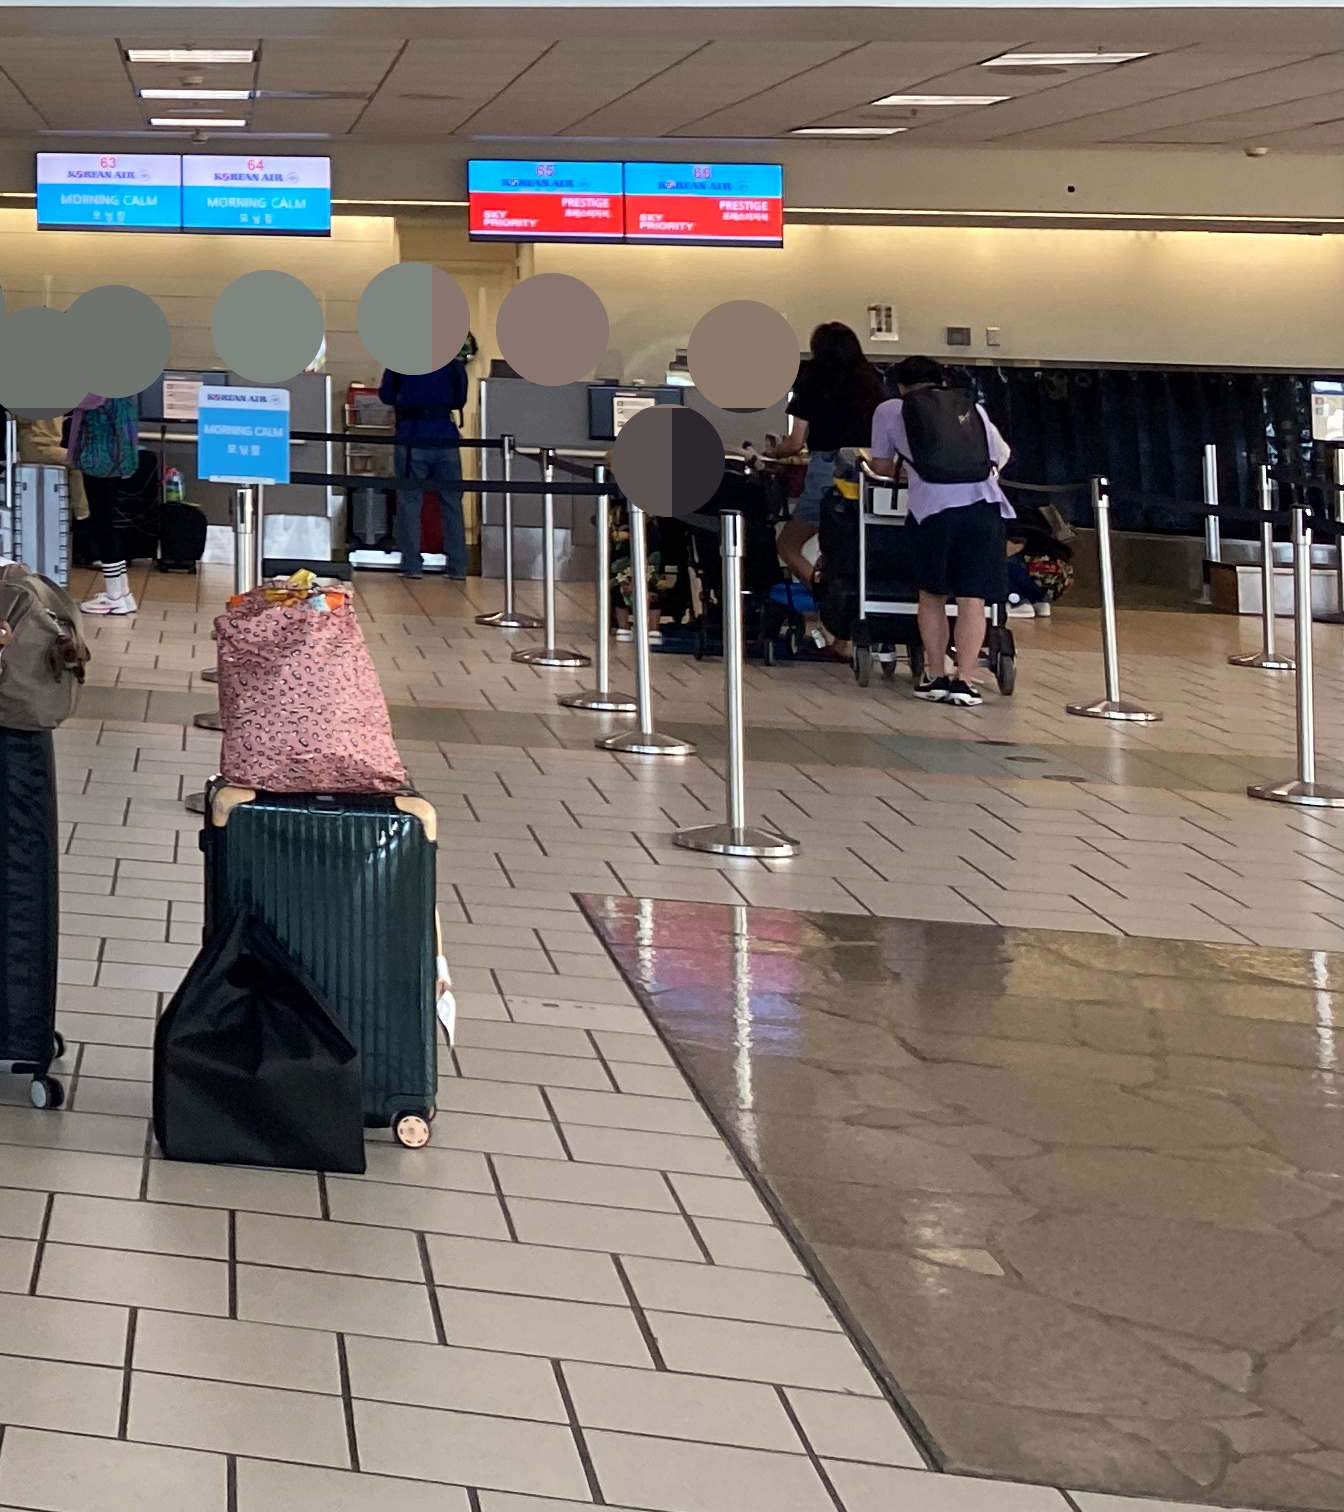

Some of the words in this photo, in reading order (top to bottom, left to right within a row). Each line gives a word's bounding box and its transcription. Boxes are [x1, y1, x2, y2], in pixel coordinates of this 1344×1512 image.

[100, 157, 117, 169] 63
[247, 159, 265, 171] 64
[67, 170, 112, 179] KOREAN
[113, 171, 136, 179] AIR
[536, 165, 554, 177] 65
[214, 173, 260, 182] KOREAN
[261, 173, 284, 182] AIR
[502, 179, 550, 188] KOREAN
[552, 180, 575, 188] AIR
[658, 181, 706, 190] KOREAN
[707, 182, 732, 190] AIR
[60, 194, 120, 206] MORNING
[122, 195, 158, 207] CALM
[206, 197, 267, 209] MORNING
[270, 198, 307, 209] CALM
[561, 197, 611, 209] PRESTIGE
[718, 200, 769, 212] PRESTIGE
[483, 210, 507, 219] SKY
[639, 213, 664, 222] SKY
[483, 219, 539, 228] PRIORITY
[639, 222, 695, 231] PRIORITY
[207, 393, 246, 402] KOREAN
[248, 395, 267, 403] AIR
[204, 424, 253, 436] MORNING
[254, 426, 284, 438] CALM
